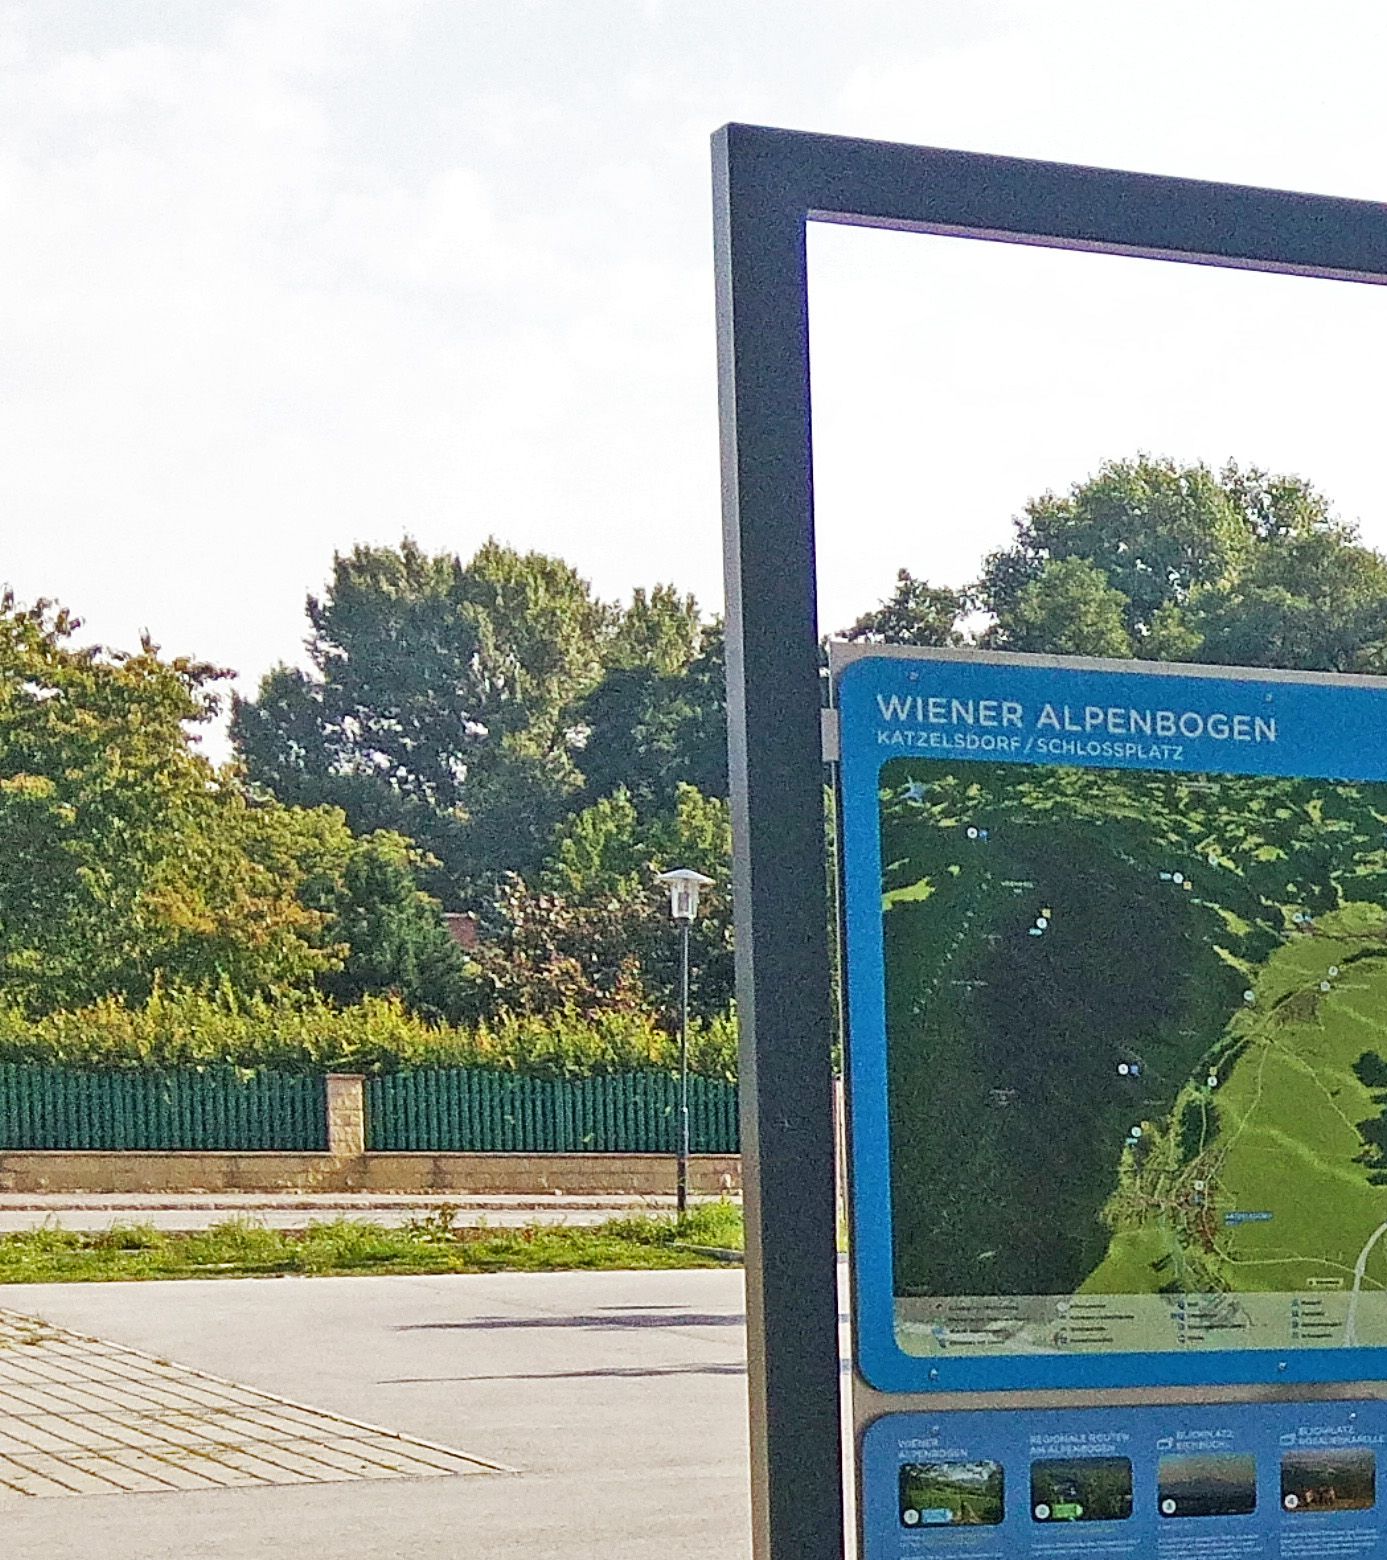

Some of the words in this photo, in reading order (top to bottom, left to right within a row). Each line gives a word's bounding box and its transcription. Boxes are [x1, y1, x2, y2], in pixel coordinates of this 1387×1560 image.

[876, 694, 1023, 728] WIENER
[1037, 703, 1278, 742] ALPENBOGEN
[877, 730, 1021, 751] KATZELSDORF
[1037, 738, 1184, 762] SCHLOSSPLATZ
